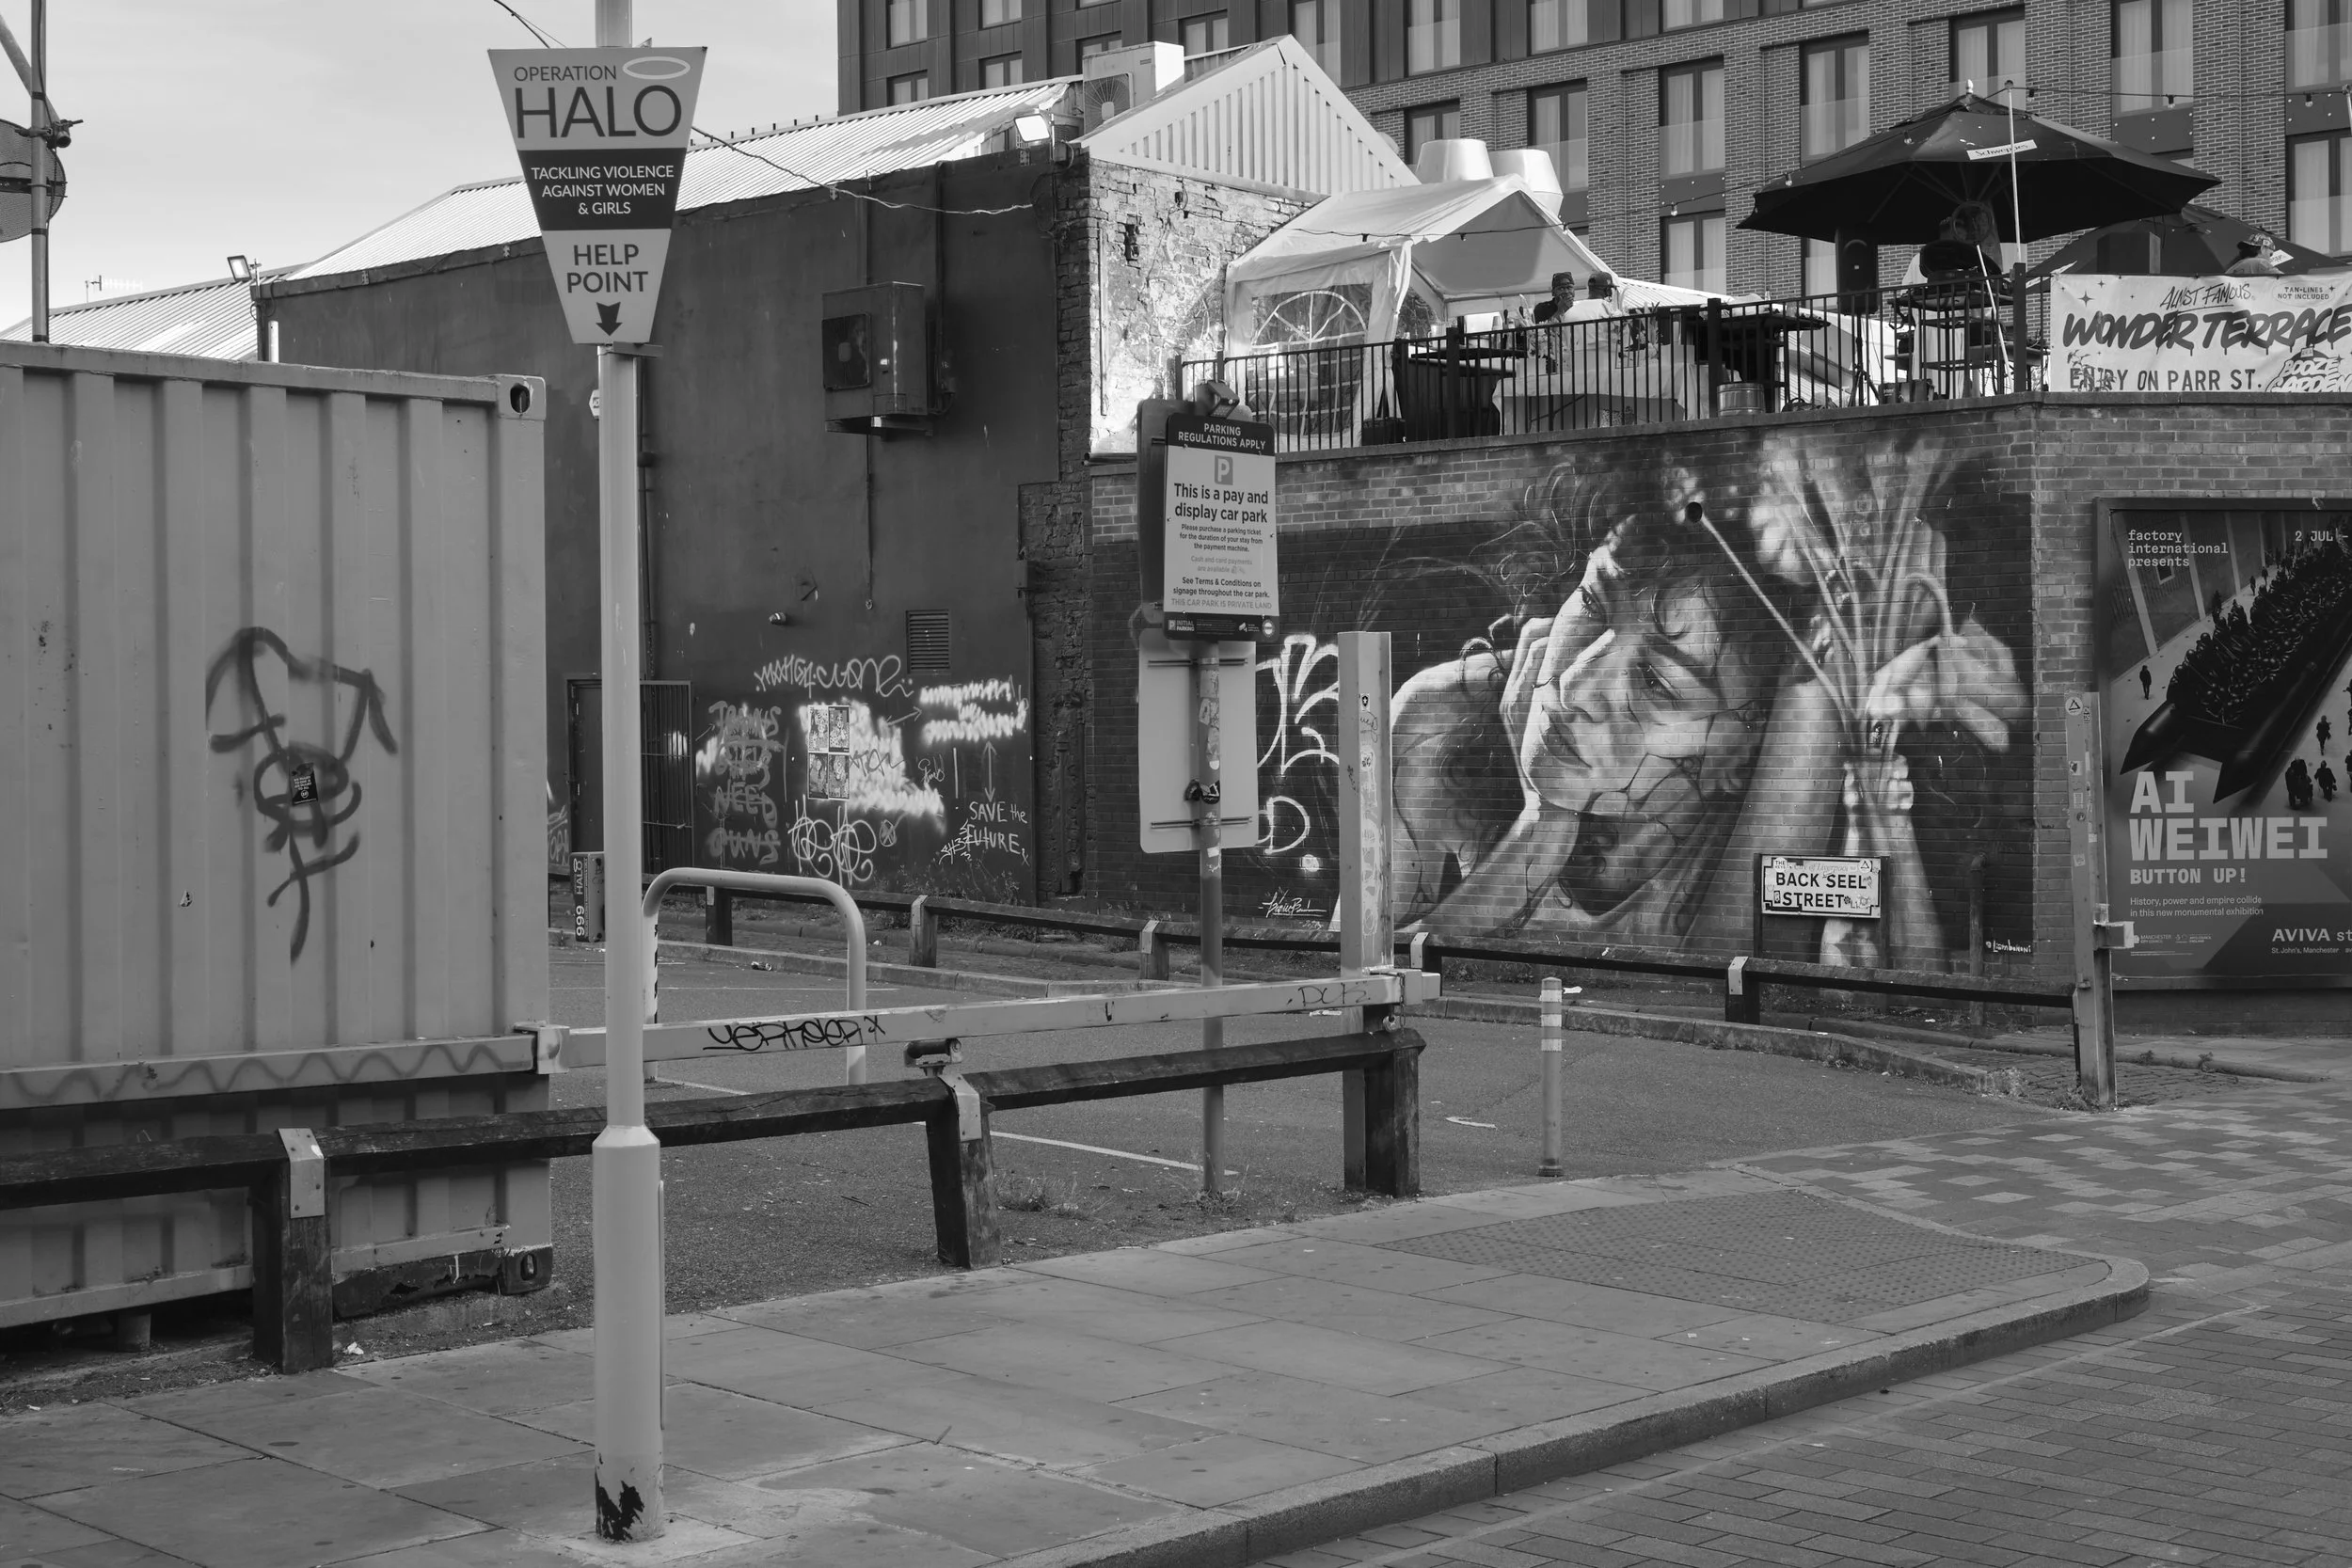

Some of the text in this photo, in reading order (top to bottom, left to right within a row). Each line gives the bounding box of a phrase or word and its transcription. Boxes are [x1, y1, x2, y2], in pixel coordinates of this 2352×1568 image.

[514, 65, 617, 82] OPERATION
[515, 85, 682, 138] HALO
[531, 165, 675, 180] TACKLING VIOLENCE
[542, 182, 665, 198] AGAINST WOMEN
[578, 201, 631, 214] & GIRLS
[573, 244, 640, 265] HELP
[566, 271, 649, 293] POINT
[2062, 304, 2352, 354] WONDER TERRACE
[2280, 357, 2339, 377] BOOZE
[2137, 370, 2159, 390] ON
[2168, 370, 2220, 390] PARR
[2231, 369, 2262, 390] ST.
[1204, 423, 1241, 436] PARKING
[1178, 432, 1266, 450] REGULATIONS APPLY
[1217, 458, 1230, 483] P
[1174, 483, 1268, 504] This is a pay and
[1175, 502, 1267, 524] display car park
[1199, 533, 1219, 542] duration
[1200, 525, 1222, 533] purchase
[1228, 527, 1246, 535] parking
[2128, 530, 2183, 543] factory
[2295, 531, 2302, 542] 2
[2311, 531, 2333, 542] JUL
[2128, 543, 2229, 554] international
[2128, 557, 2190, 569] presents
[1220, 578, 1252, 587] Conditions
[1173, 587, 1197, 595] signage
[1199, 588, 1232, 597] throughout
[1186, 598, 1200, 607] CAR
[1227, 600, 1254, 609] PRIVATE
[2130, 770, 2194, 814] AI
[969, 800, 1027, 824] SAVE the
[2129, 816, 2328, 861] WEIWEI
[1776, 872, 1867, 889] BACK SEEL
[2130, 867, 2246, 884] BUTTON UP!
[1782, 892, 1844, 908] STREET
[2130, 895, 2262, 907] History, power and empire collide
[2130, 909, 2137, 917] in
[2138, 909, 2154, 917] this
[2174, 908, 2225, 916] monumental
[2226, 908, 2264, 916] exhibition
[576, 905, 584, 937] 999
[2272, 928, 2330, 942] AVIVA
